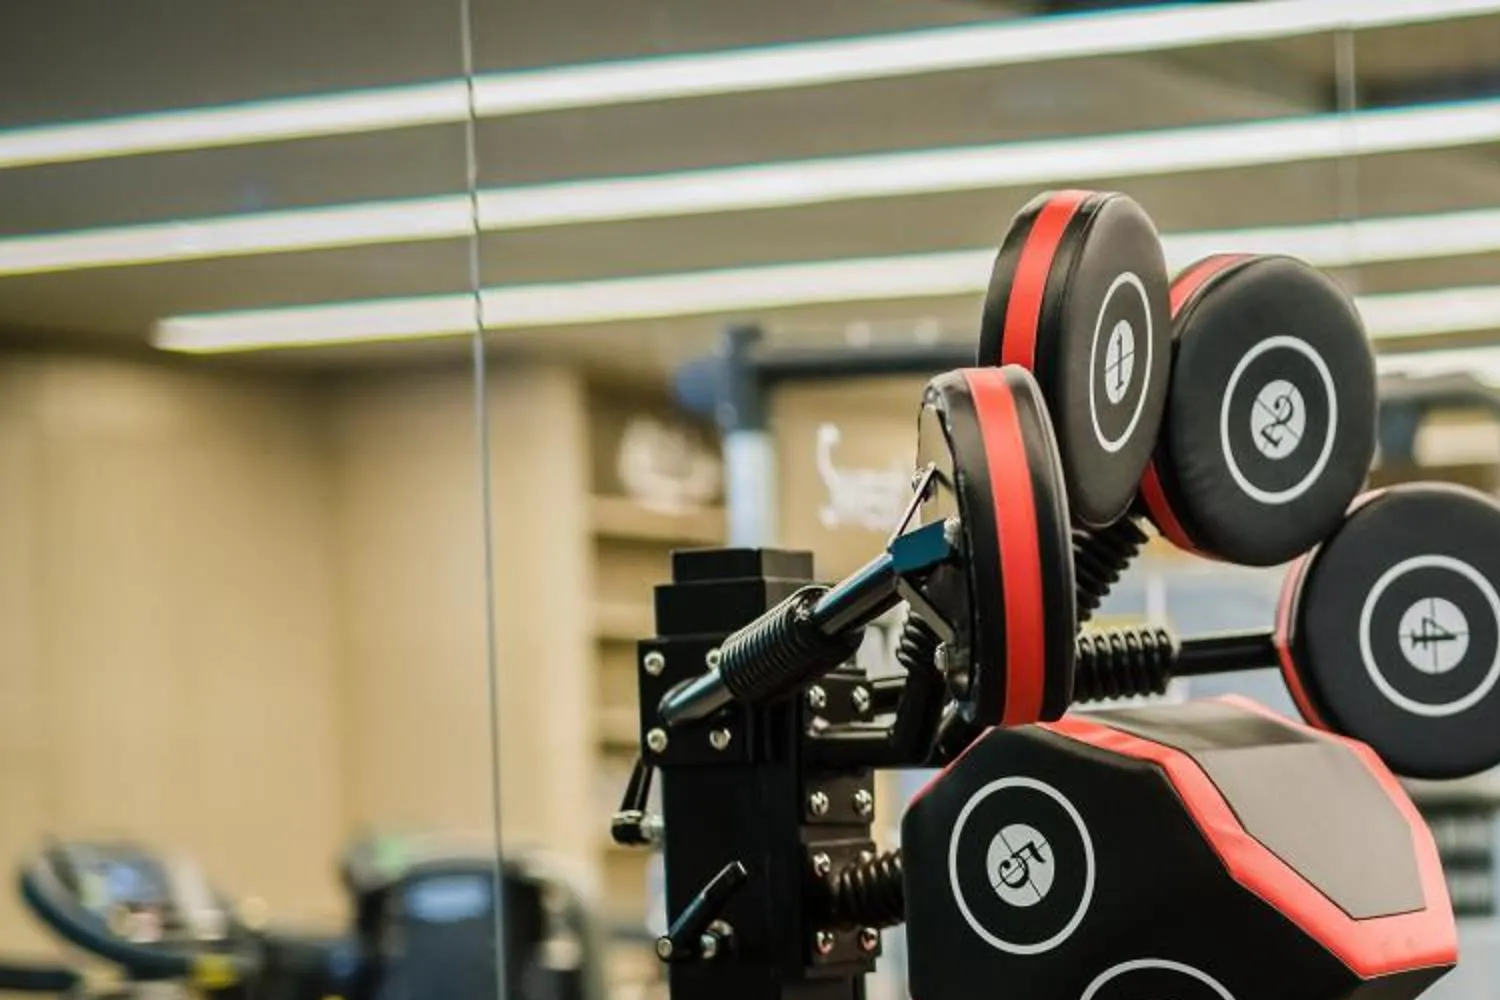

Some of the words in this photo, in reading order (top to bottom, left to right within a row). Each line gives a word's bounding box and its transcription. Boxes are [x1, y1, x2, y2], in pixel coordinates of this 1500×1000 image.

[1115, 334, 1125, 391] 1
[1261, 395, 1294, 448] 2
[1410, 616, 1457, 651] 4
[999, 841, 1046, 889] 5
